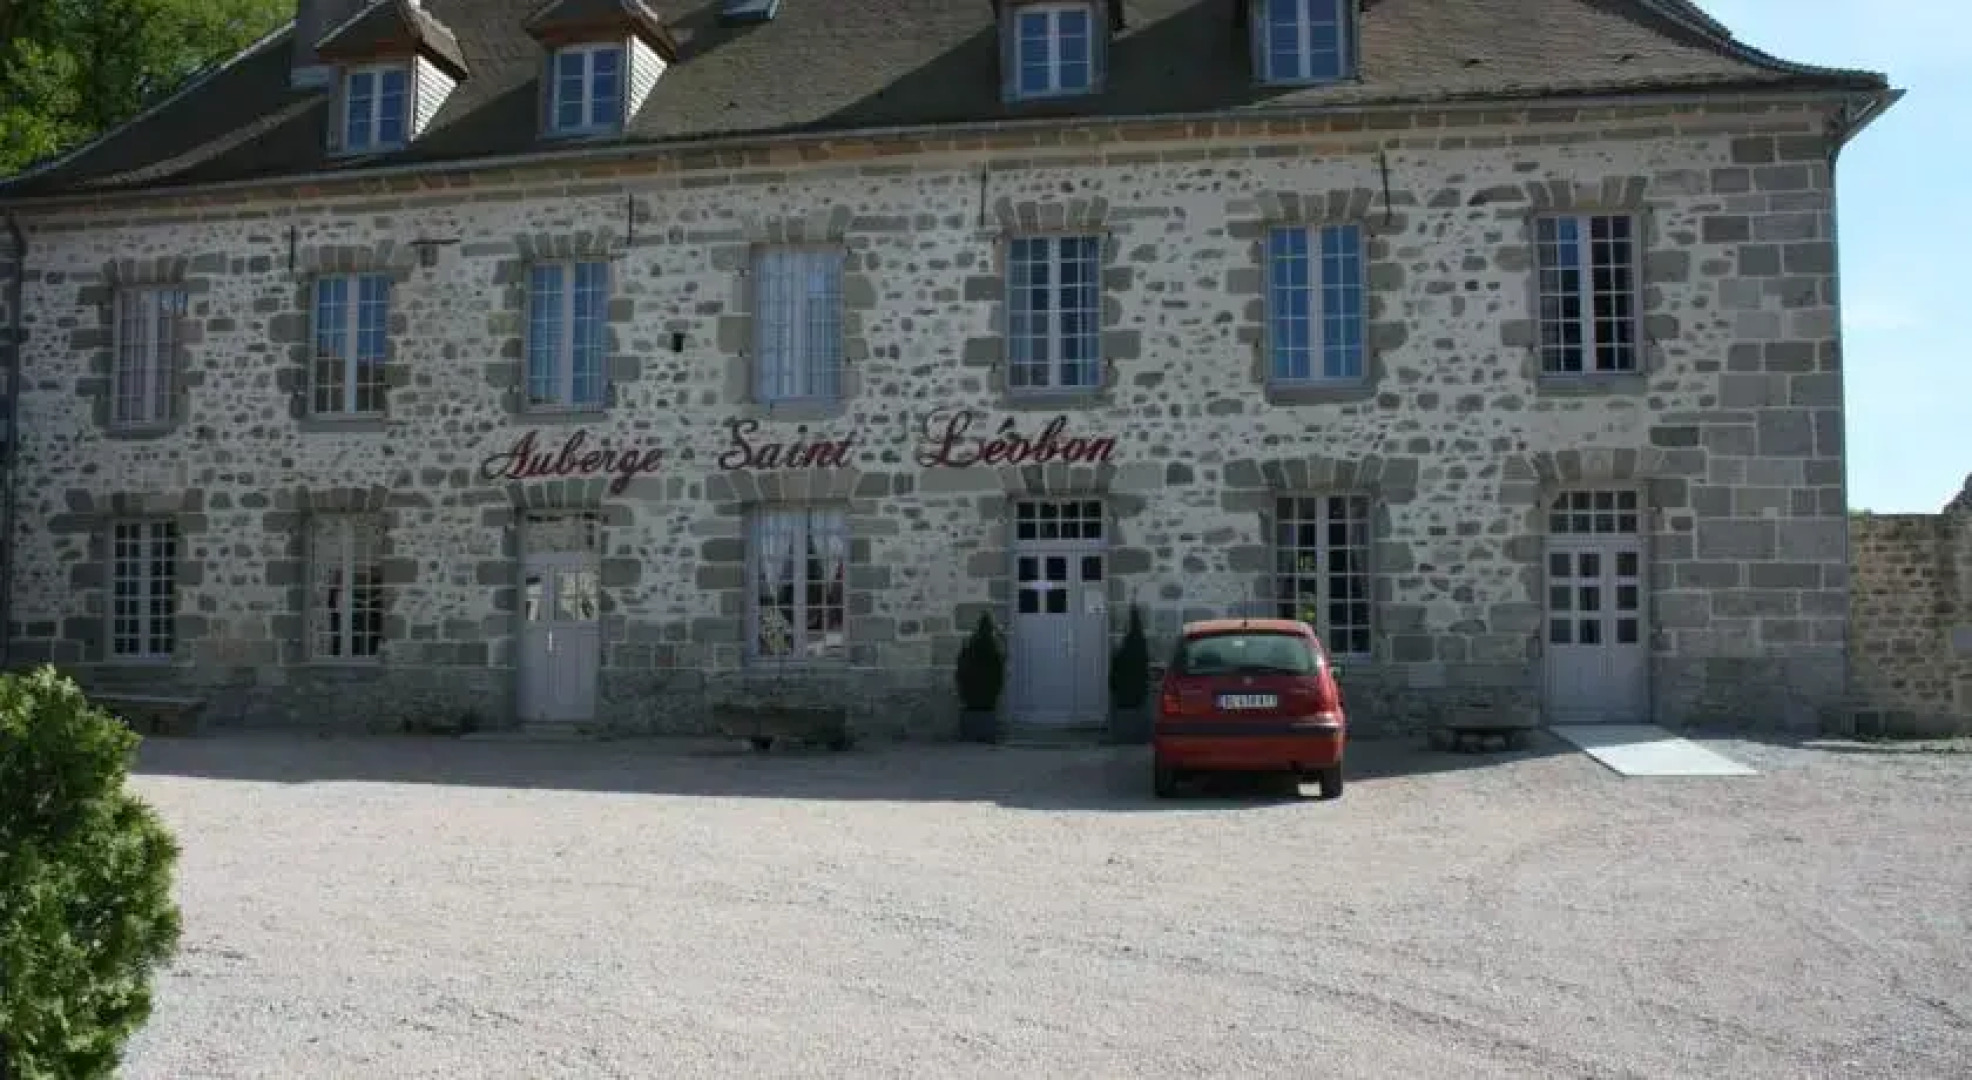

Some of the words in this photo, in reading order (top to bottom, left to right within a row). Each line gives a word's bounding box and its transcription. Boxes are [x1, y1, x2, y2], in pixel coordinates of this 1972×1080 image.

[481, 429, 663, 495] Auberge
[719, 419, 857, 470] Saint
[917, 410, 1116, 467] Léobon
